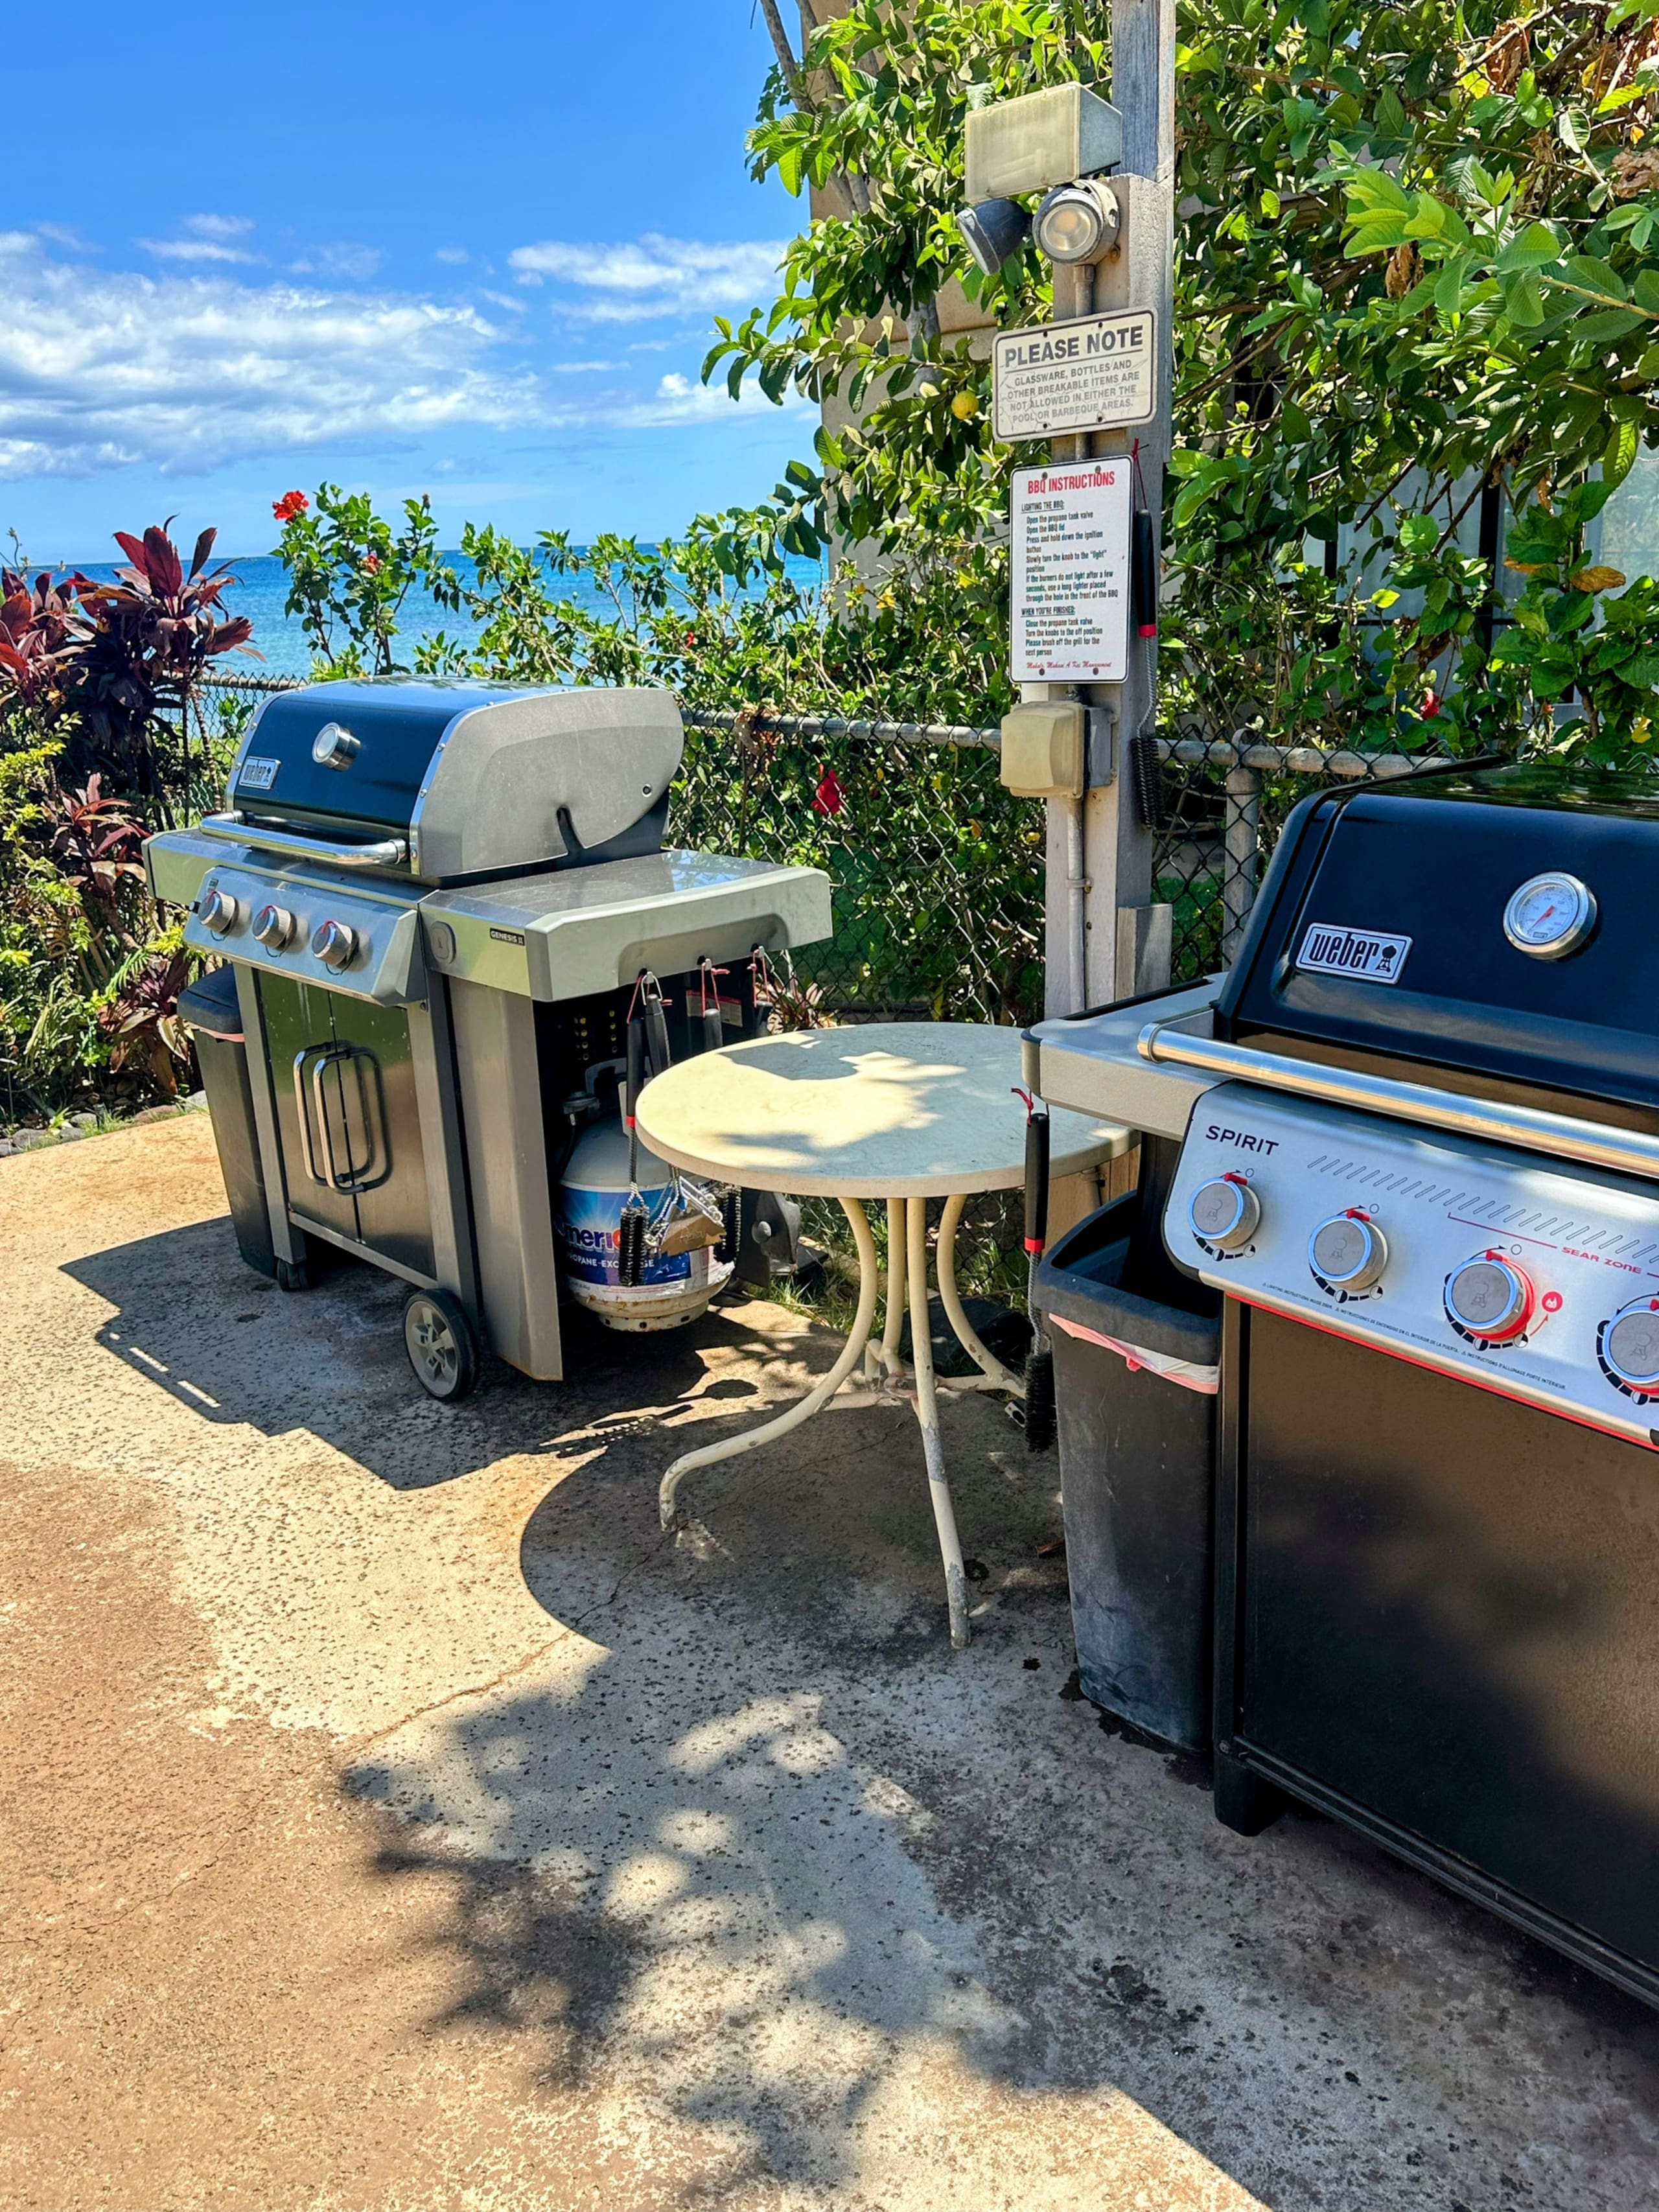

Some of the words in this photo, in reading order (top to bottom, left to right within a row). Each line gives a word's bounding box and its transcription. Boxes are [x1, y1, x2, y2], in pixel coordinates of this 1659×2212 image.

[1005, 336, 1080, 367] PLEASE
[1087, 325, 1143, 353] NOTE
[1015, 370, 1068, 386] GLASSWARE,
[1071, 362, 1110, 377] BOTTLES
[1113, 359, 1131, 370] AND
[1008, 388, 1036, 400] OTHER
[1038, 379, 1089, 395] BREAKABLE
[1091, 374, 1119, 386] ITEMS
[1121, 371, 1139, 382] ARE
[1010, 401, 1027, 412] NOT
[1030, 393, 1069, 409] ALLOWED
[1073, 391, 1082, 402] IN
[1084, 387, 1116, 401] EITHER
[1119, 384, 1136, 394] THE
[1012, 412, 1037, 423] POOL
[1038, 408, 1049, 419] OR
[1052, 403, 1098, 418] BARBEQUE
[1028, 480, 1045, 494] BBQ
[1049, 471, 1115, 492] INSTRUCTIONS
[1021, 502, 1042, 512] LIGHTING
[1027, 516, 1038, 525] Open
[1048, 514, 1067, 523] propane
[1027, 526, 1038, 535] Open
[1048, 523, 1058, 532] BBQ
[1050, 533, 1060, 542] hold
[1021, 607, 1034, 616] WHEN
[491, 931, 518, 943] GENESIS
[1309, 932, 1380, 970] weber
[1205, 1125, 1279, 1156] SPIRIT
[1562, 1247, 1600, 1262] SEAR
[1604, 1258, 1642, 1274] ZONE
